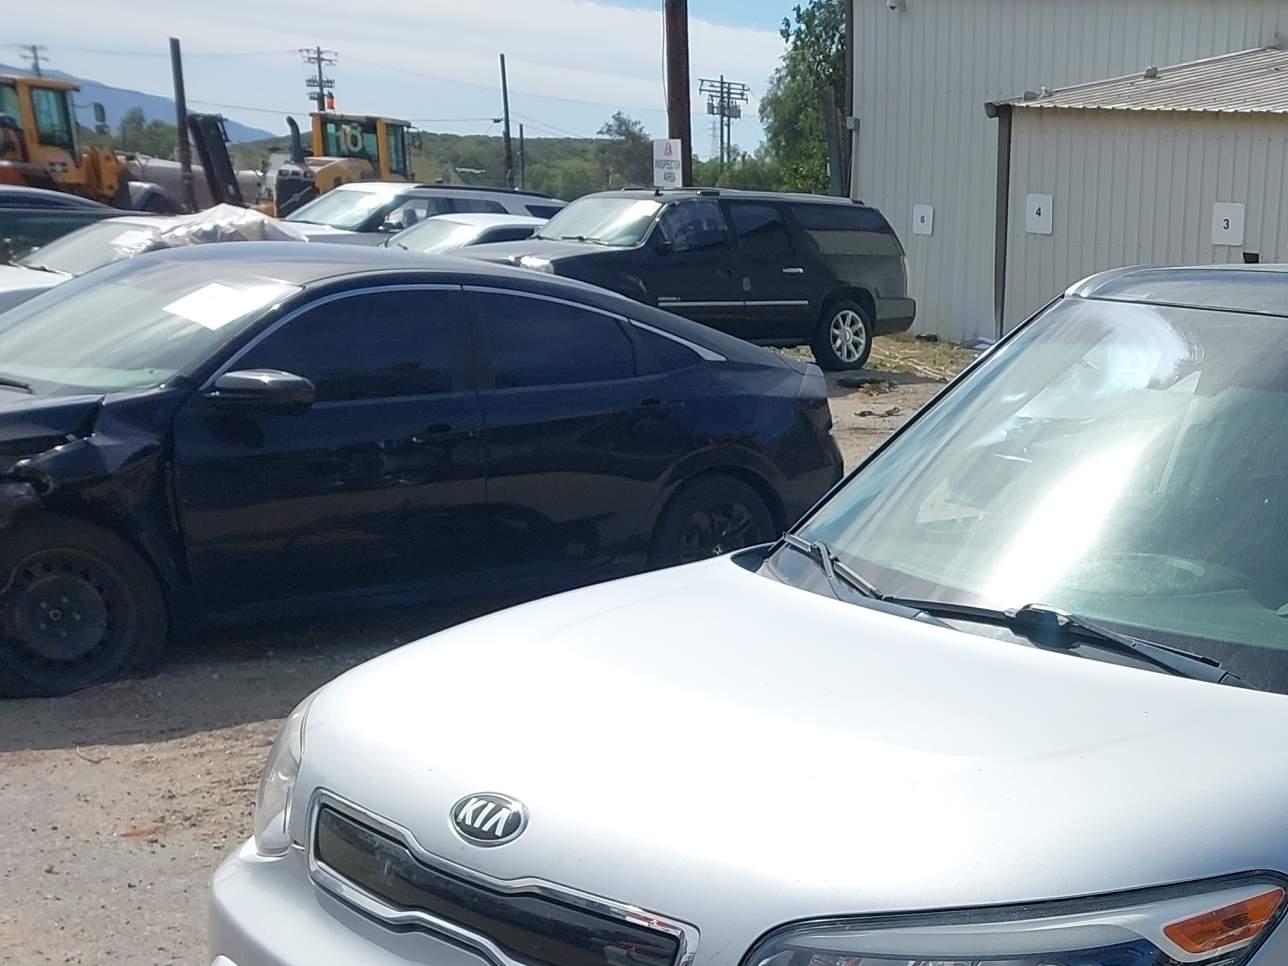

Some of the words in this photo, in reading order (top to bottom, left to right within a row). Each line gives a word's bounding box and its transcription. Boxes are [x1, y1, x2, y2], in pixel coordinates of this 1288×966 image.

[1035, 205, 1042, 217] 4
[1223, 218, 1230, 230] 3
[456, 797, 513, 837] KIA
